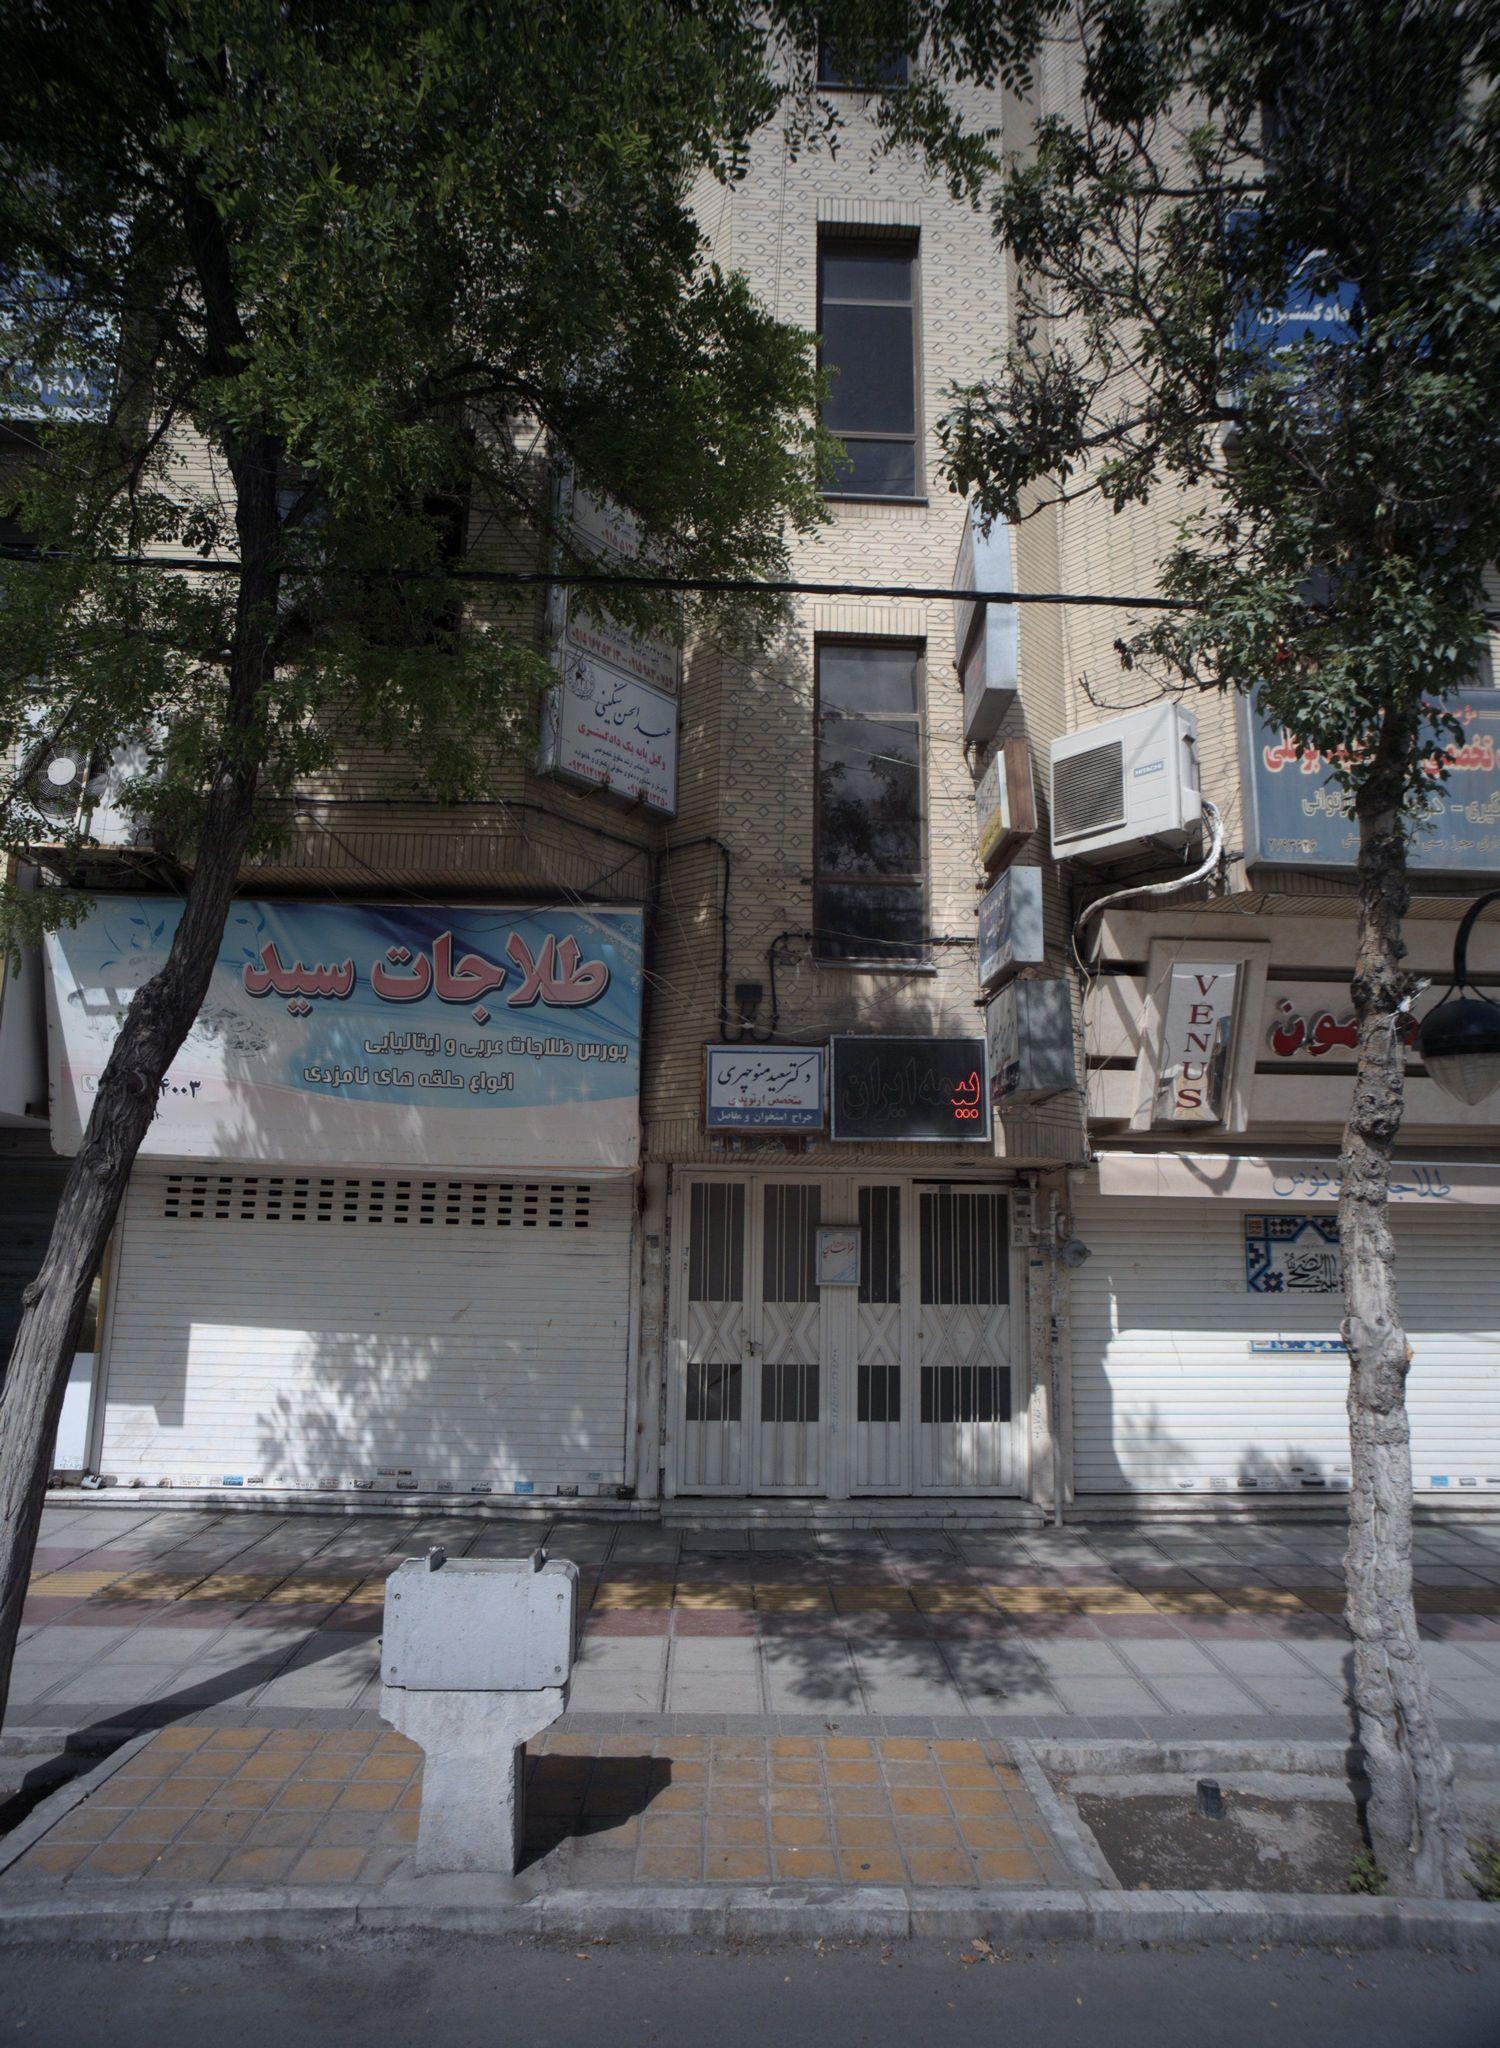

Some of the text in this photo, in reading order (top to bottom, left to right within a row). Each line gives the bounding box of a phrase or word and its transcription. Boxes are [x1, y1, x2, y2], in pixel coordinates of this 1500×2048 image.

[241, 929, 612, 1025] طلاجات سید
[364, 1032, 628, 1062] بورس طلاجات عربی و ایتالیایی
[1176, 974, 1218, 1110] VENUS
[303, 1066, 515, 1094] انواع حلقه های نامزدی
[717, 1062, 771, 1094] منوچهری
[775, 1055, 816, 1094] دکتر
[767, 1094, 803, 1106] متخصص
[716, 1110, 743, 1123] مفاصل
[753, 1111, 788, 1123] استخوان
[791, 1112, 813, 1124] جراح
